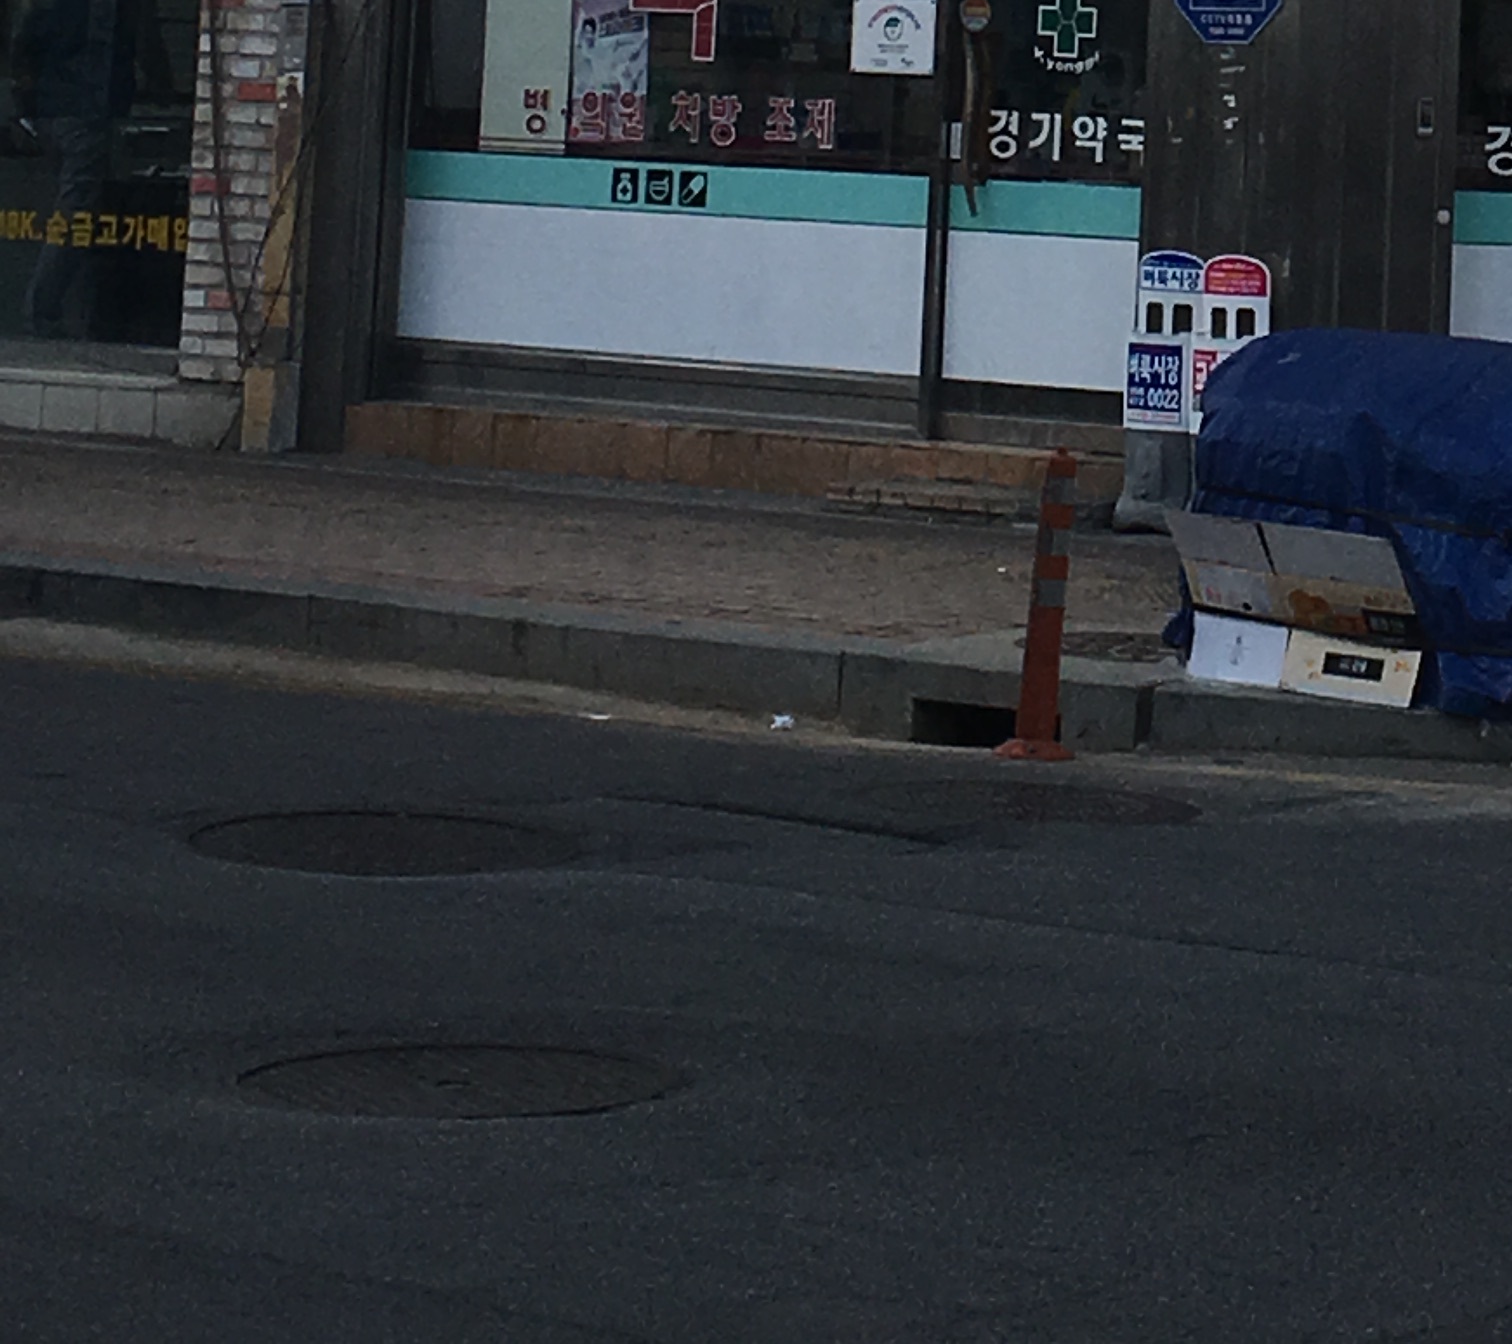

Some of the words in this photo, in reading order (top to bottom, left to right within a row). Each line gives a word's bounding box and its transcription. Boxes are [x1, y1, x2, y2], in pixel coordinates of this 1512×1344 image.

[669, 89, 743, 148] 처방
[763, 96, 837, 151] 조제
[1146, 387, 1180, 410] 0022
